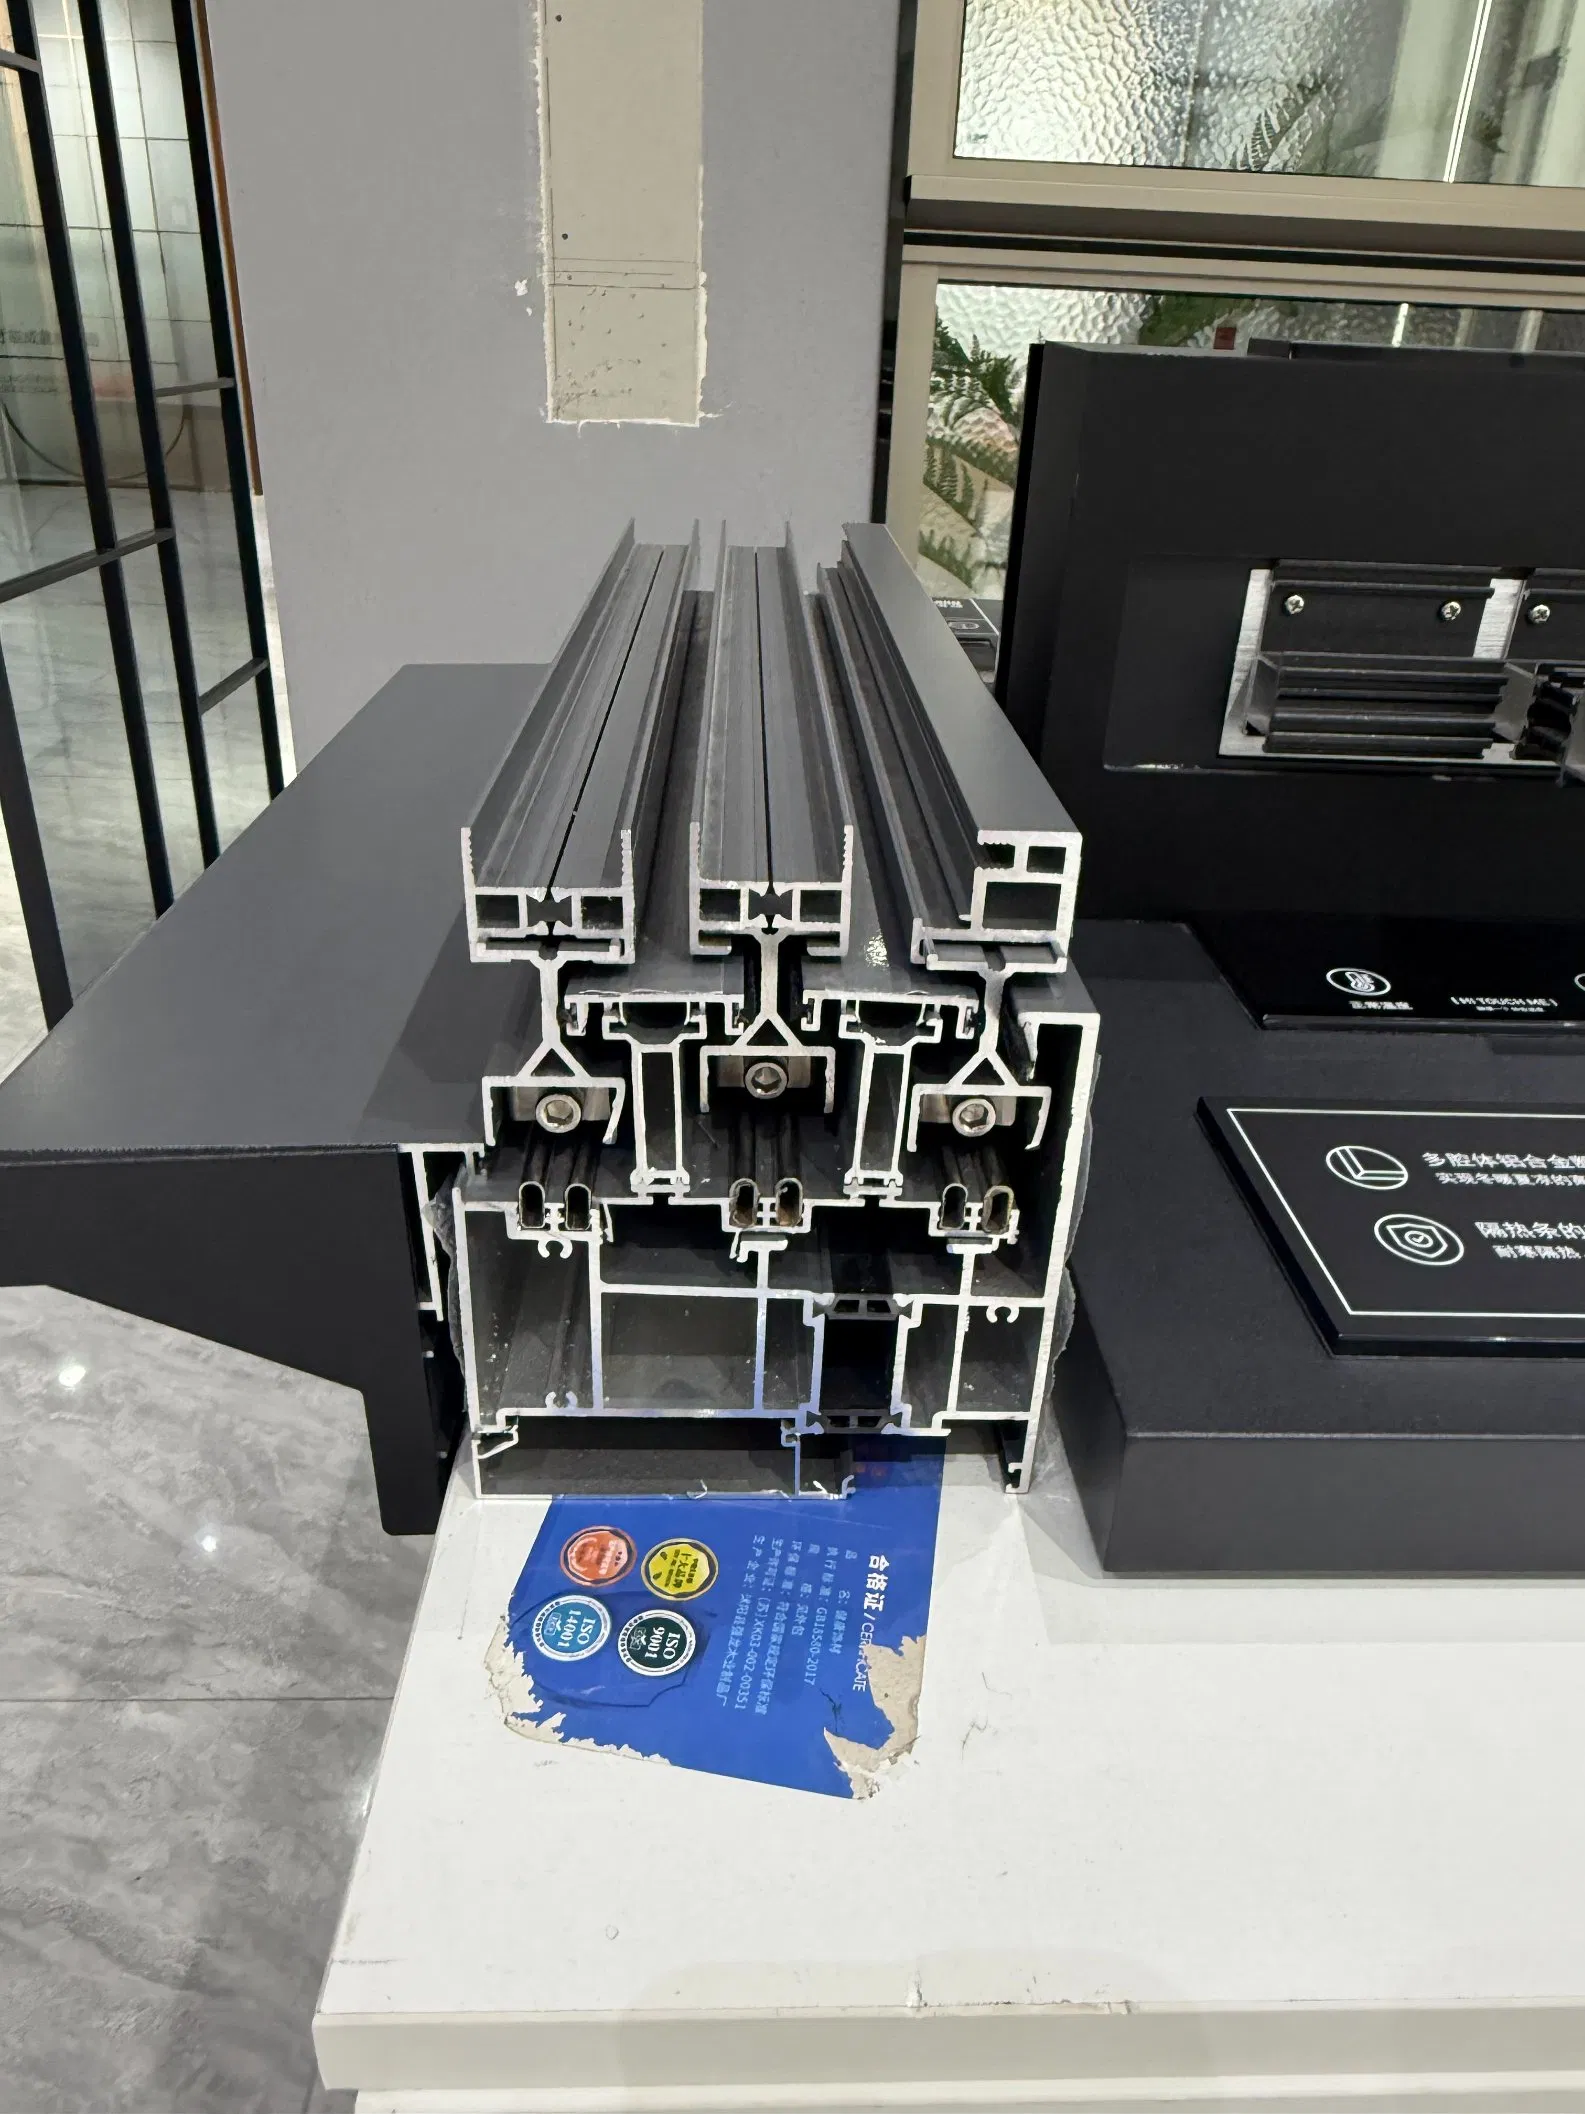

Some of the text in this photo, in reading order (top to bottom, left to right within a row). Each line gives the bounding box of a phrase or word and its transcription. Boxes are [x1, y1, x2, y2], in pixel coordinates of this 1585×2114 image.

[1474, 1222, 1585, 1239] 隔热条的
[864, 1555, 890, 1611] 合格证
[557, 1610, 582, 1647] 14001
[577, 1618, 596, 1645] ISO
[645, 1626, 665, 1658] 9001
[663, 1632, 681, 1660] ISO
[853, 1623, 874, 1692] CERCATE
